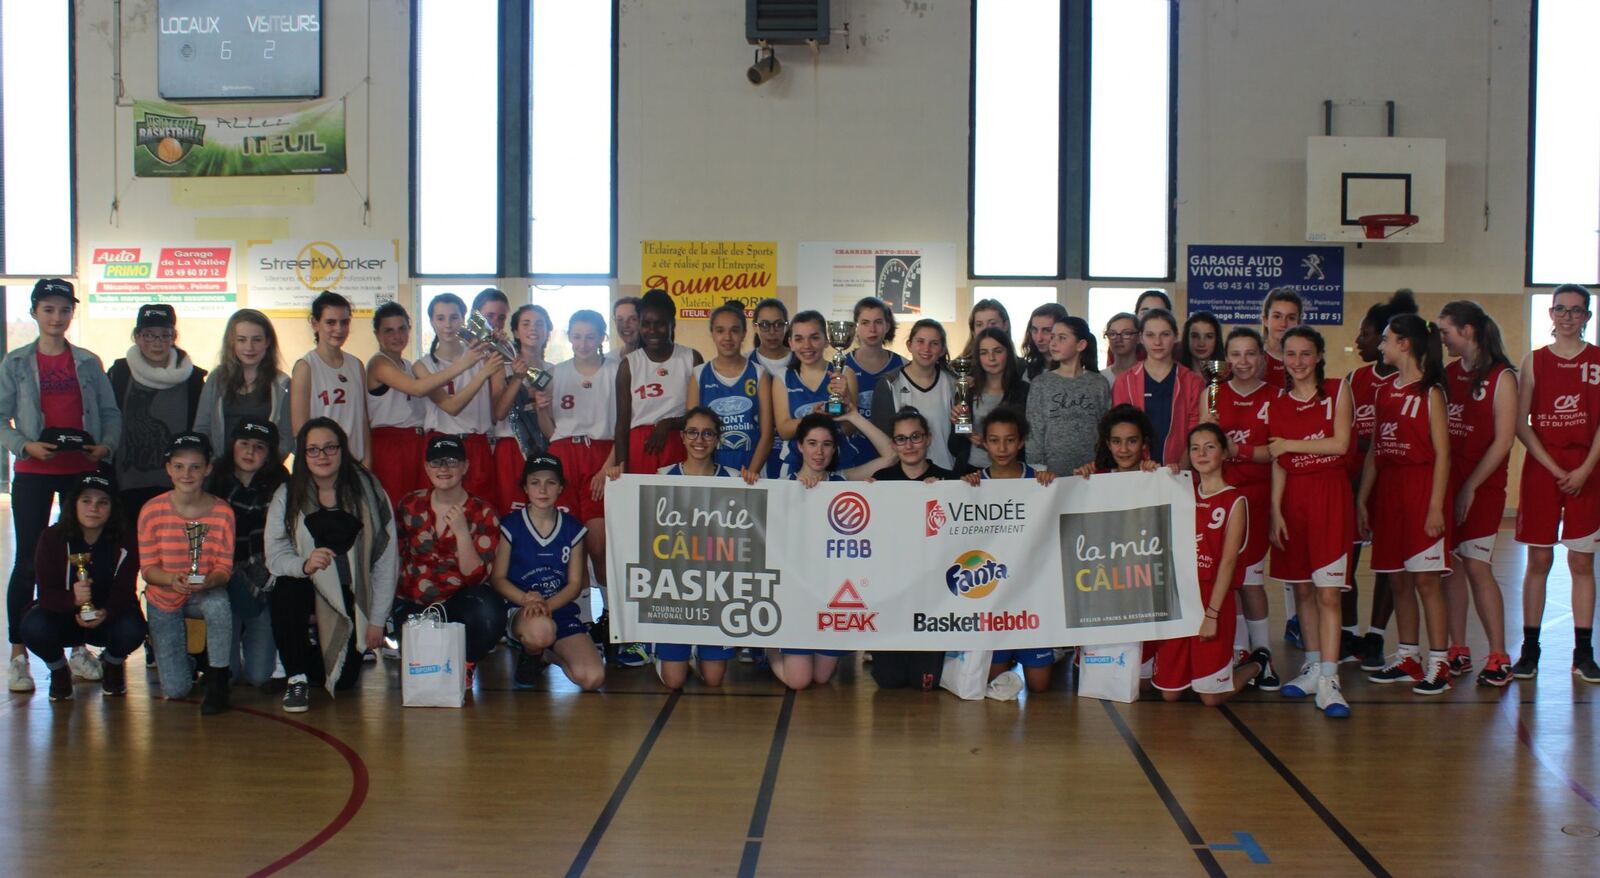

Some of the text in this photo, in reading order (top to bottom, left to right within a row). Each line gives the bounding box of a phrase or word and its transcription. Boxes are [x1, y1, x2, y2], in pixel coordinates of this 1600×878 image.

[160, 16, 220, 34] LOCAUX
[247, 15, 320, 33] VISITEURS
[220, 41, 232, 60] 6
[263, 40, 275, 59] 2
[242, 133, 325, 154] ITEUIL
[98, 250, 136, 262] Auto
[173, 250, 213, 258] Garage
[688, 242, 699, 255] de
[701, 242, 709, 255] la
[711, 242, 728, 255] salle
[730, 242, 744, 255] des
[746, 243, 774, 258] Sports
[260, 258, 387, 270] StreetWorker
[702, 259, 716, 271] par
[1190, 255, 1283, 266] GARAGE AUTO
[106, 264, 149, 278] PRIMO
[1190, 266, 1282, 277] VIVONNE SUD
[1203, 282, 1214, 290] 05
[1217, 282, 1228, 290] 49
[1231, 282, 1242, 290] 43
[682, 309, 708, 317] ITEUIL
[1580, 361, 1600, 386] 13
[318, 388, 347, 406] 12
[634, 383, 664, 400] 13
[745, 379, 757, 397] 6
[561, 395, 575, 410] 8
[1401, 395, 1421, 418] 11
[1256, 401, 1270, 425] 4
[656, 497, 754, 530] la mie
[948, 499, 1026, 522] VENDÉE
[1207, 506, 1226, 530] 9
[949, 526, 959, 536] LE
[652, 530, 752, 563] CÂLINE
[826, 539, 873, 559] FFBB
[1075, 529, 1164, 562] la mie
[561, 546, 571, 564] 8
[629, 567, 777, 603] BASKET
[945, 560, 1008, 597] Fanta
[1074, 562, 1165, 592] CÂLINE
[647, 612, 684, 621] NATIONAL
[651, 605, 684, 614] TOURNOI
[685, 606, 710, 622] U15
[720, 601, 779, 635] GO
[817, 612, 878, 633] PEAK
[913, 611, 1040, 633] BasketHebdo
